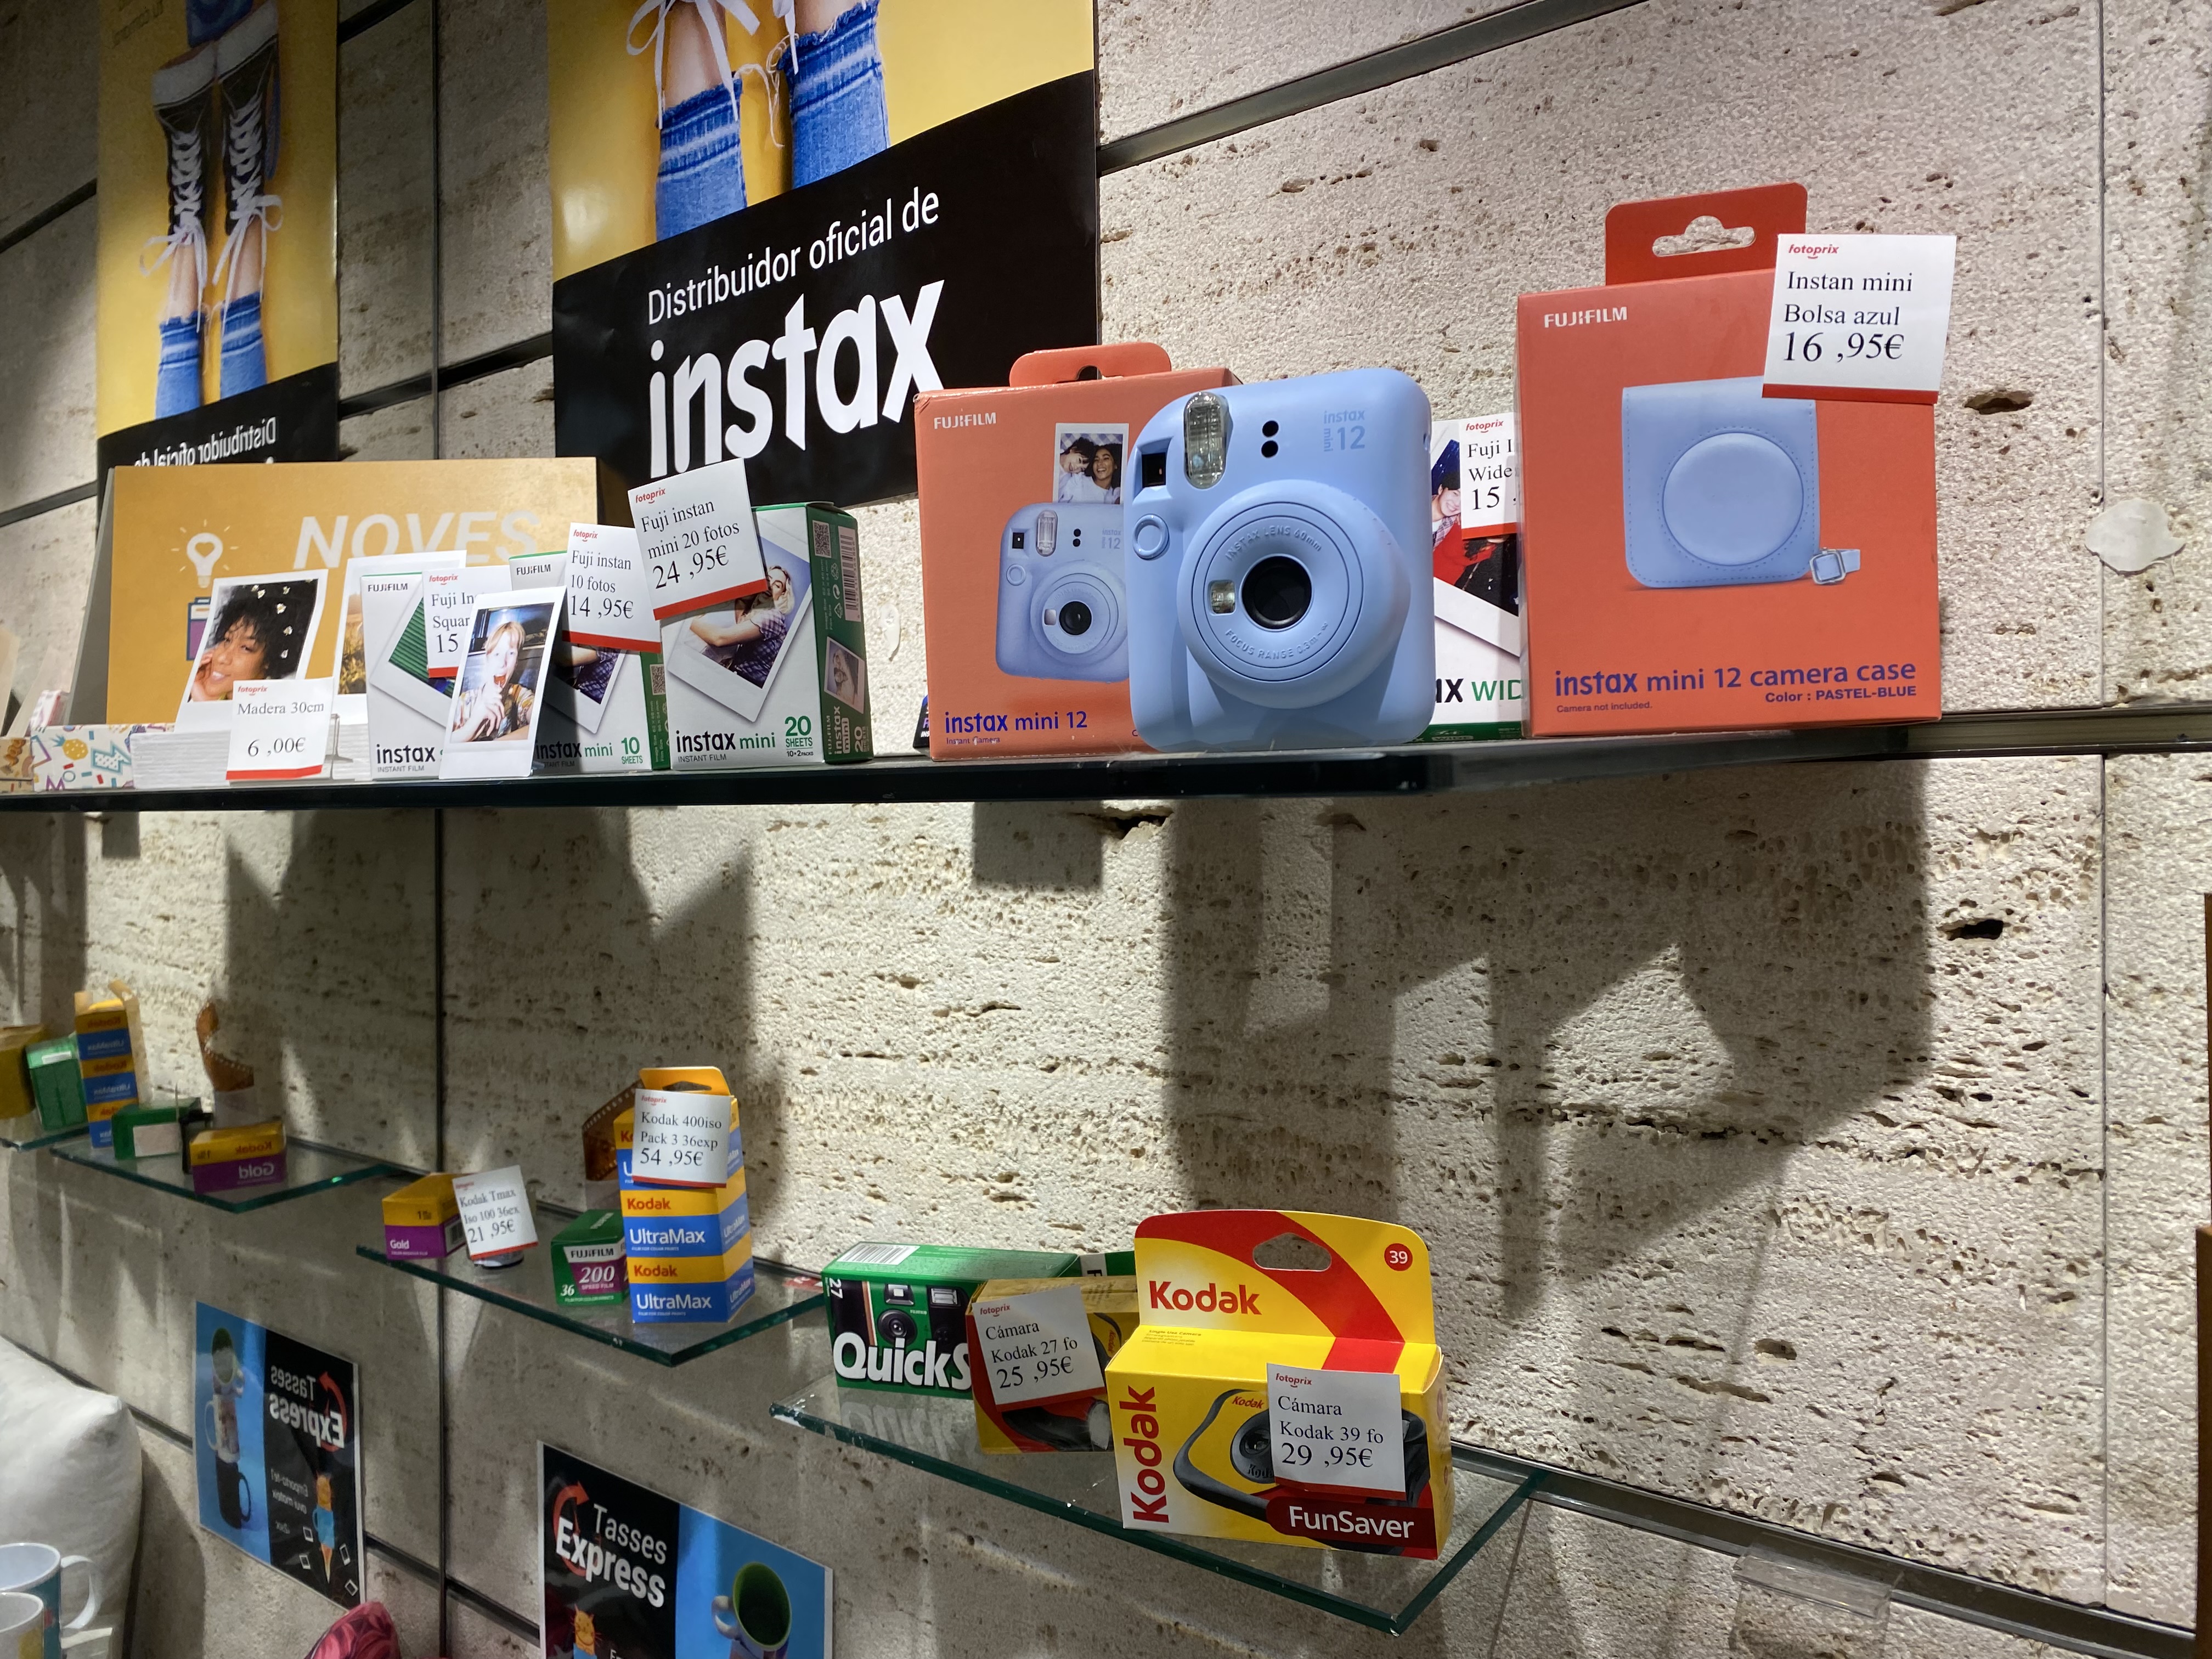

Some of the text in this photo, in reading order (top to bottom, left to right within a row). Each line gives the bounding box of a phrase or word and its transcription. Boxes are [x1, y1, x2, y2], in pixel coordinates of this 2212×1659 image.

[648, 187, 939, 325] Distribuidor oficial de
[1788, 243, 1839, 257] fotoprix
[1787, 271, 1913, 292] Instan mini
[1544, 307, 1627, 328] FUJIFILM
[1784, 303, 1900, 326] Bolsa azul
[1784, 332, 1823, 362] 16
[650, 280, 944, 479] instax
[934, 412, 996, 430] FUJIFILM
[1324, 410, 1365, 424] instax
[1466, 420, 1504, 431] fotoprix
[1324, 425, 1365, 452] mini 12
[1468, 440, 1500, 459] Fuji
[1469, 465, 1513, 482] Wide
[635, 488, 666, 503] fotoprix
[1472, 486, 1499, 510] 15
[641, 500, 715, 533] Fuji instan
[293, 510, 540, 569] NOVES
[573, 529, 598, 540] fotoprix
[647, 522, 740, 559] mini 20 fotos
[1108, 537, 1120, 549] 12
[1225, 525, 1322, 561] INSTAX LENS 60mm
[571, 550, 631, 570] Fuji instan
[429, 574, 458, 584] fotoprix
[517, 564, 551, 576] FUJIFILM
[653, 560, 680, 589] 24
[368, 583, 408, 592] FUJIFILM
[571, 575, 616, 592] 10 fotos
[432, 592, 456, 608] Fuji
[571, 595, 590, 617] 14
[433, 616, 470, 631] Squar
[437, 634, 458, 653] 15
[1225, 629, 1255, 656] FOCUS
[1257, 648, 1294, 659] RANGE
[1555, 662, 1916, 696] instax mini 12 camera case
[1471, 679, 1524, 701] WID
[1765, 686, 1916, 704] Color PASTEL-BLUE
[237, 701, 324, 715] Madera 30cm
[1556, 701, 1652, 713] Camera not included.
[785, 715, 811, 736] 20
[834, 706, 842, 754] instax
[945, 711, 1008, 733] instax
[1015, 712, 1059, 730] mini
[1066, 711, 1087, 729] 12
[247, 739, 259, 757] 6
[621, 737, 640, 755] 10
[676, 730, 776, 752] instax mini
[786, 737, 813, 747] SHEETS
[854, 726, 863, 752] 20
[973, 736, 1000, 744] Camera
[376, 744, 436, 764] instax
[535, 740, 613, 760] instax mini
[622, 755, 643, 764] SHEETS
[641, 1112, 721, 1128] Kodak 400iso
[641, 1131, 667, 1144] Pack
[672, 1134, 678, 1145] 3
[682, 1135, 718, 1151] 36exp
[640, 1148, 662, 1165] 54
[460, 1189, 516, 1207] Kodak Tmax
[627, 1198, 671, 1210] Kodak
[464, 1215, 477, 1224] Iso
[479, 1209, 495, 1221] 100
[467, 1226, 484, 1243] 21
[629, 1228, 706, 1245] UltraMax
[390, 1239, 410, 1250] Gold
[571, 1248, 614, 1258] FUJIFILM
[1389, 1251, 1409, 1265] 39
[579, 1266, 615, 1284] 200
[634, 1265, 678, 1277] Kodak
[560, 1284, 575, 1296] 36
[829, 1278, 843, 1299] 27
[1149, 1280, 1261, 1315] Kodak
[636, 1293, 712, 1310] UltraMax
[980, 1304, 1010, 1314] fotoprix
[986, 1323, 1040, 1340] Cámara
[991, 1337, 1077, 1363] Kodak 27 fo
[833, 1332, 972, 1391] QuickS
[996, 1366, 1023, 1389] 25
[1276, 1373, 1312, 1385] fotoprix
[1232, 1396, 1264, 1409] Kodak
[1278, 1396, 1342, 1415] Cámara
[1279, 1420, 1384, 1443] Kodak 39 fo
[1119, 1386, 1169, 1523] Kodak
[1282, 1442, 1312, 1466] 29
[1289, 1506, 1414, 1538] FunSaver
[594, 1503, 667, 1565] Tasses
[556, 1516, 665, 1607] Express
